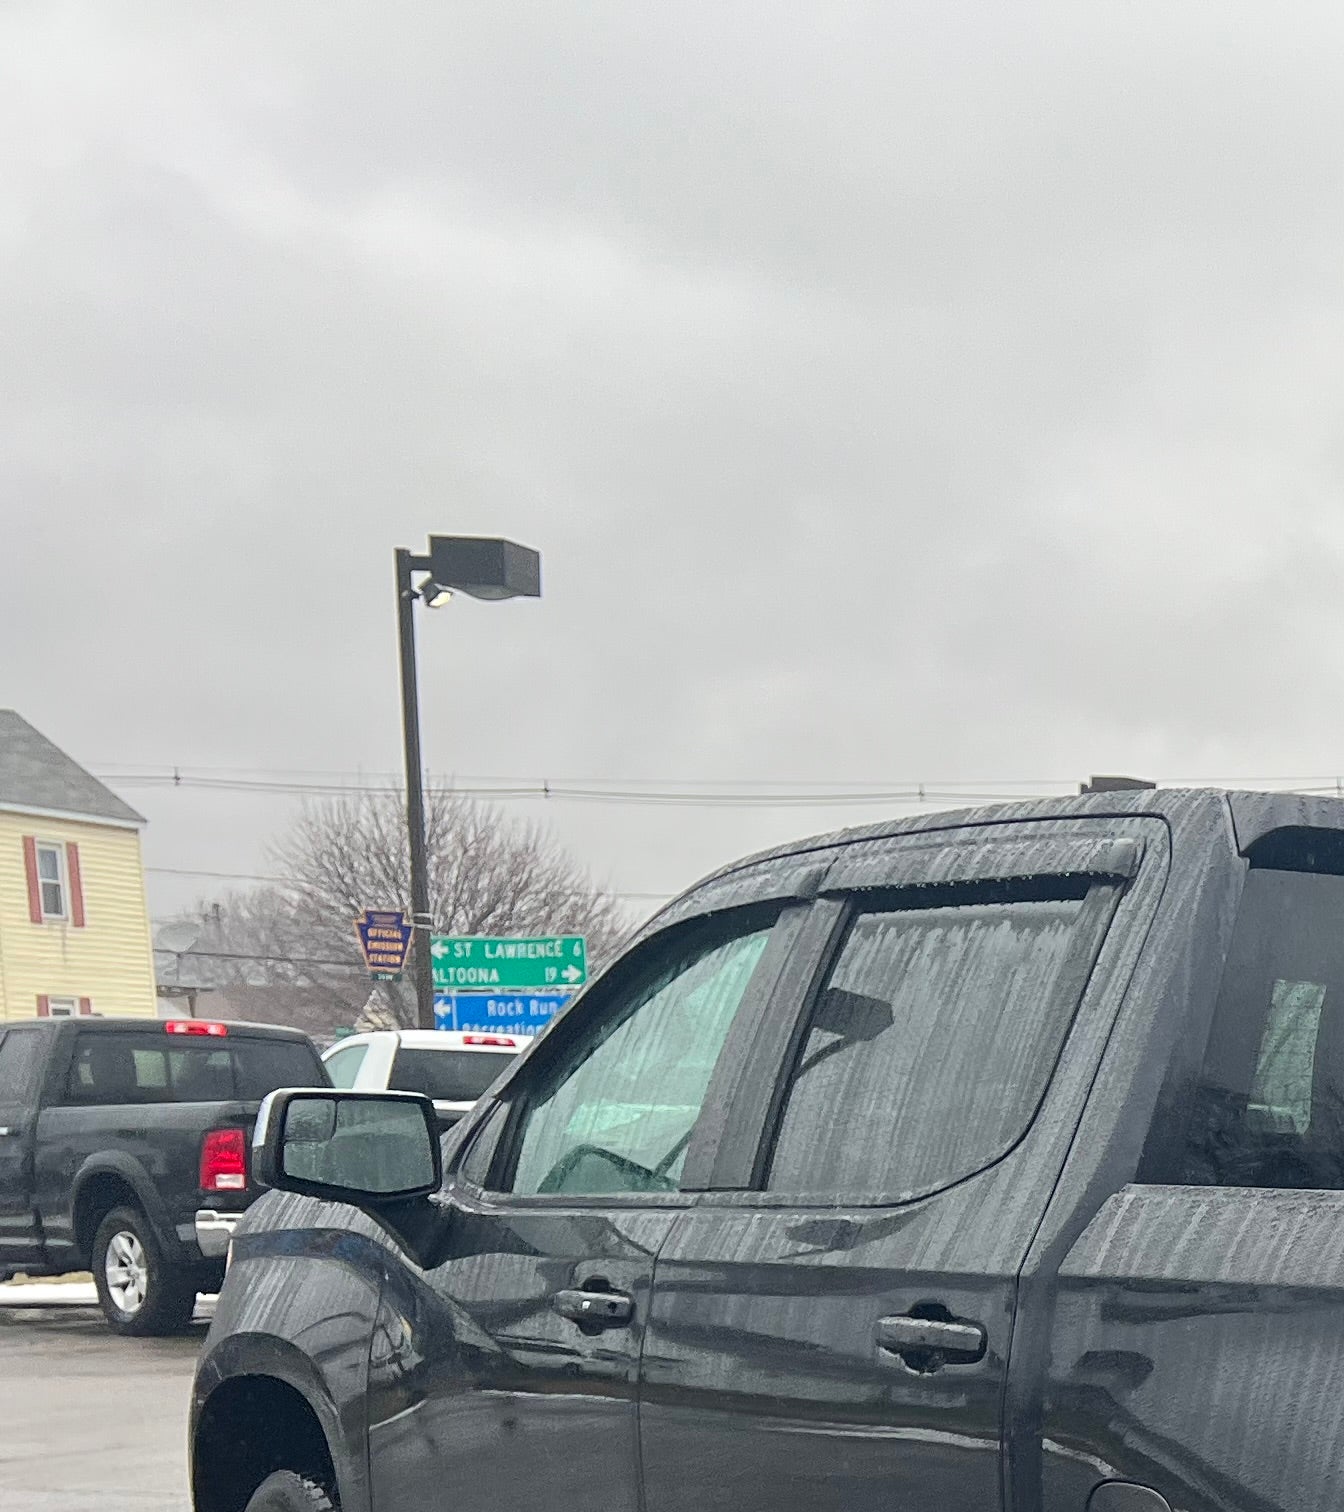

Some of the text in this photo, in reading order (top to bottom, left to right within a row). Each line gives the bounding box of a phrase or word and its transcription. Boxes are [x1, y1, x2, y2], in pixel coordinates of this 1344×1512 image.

[453, 940, 582, 959] ST LAWRENCE 6
[432, 966, 558, 983] ALTOONA 19
[487, 999, 559, 1017] Rock Run
